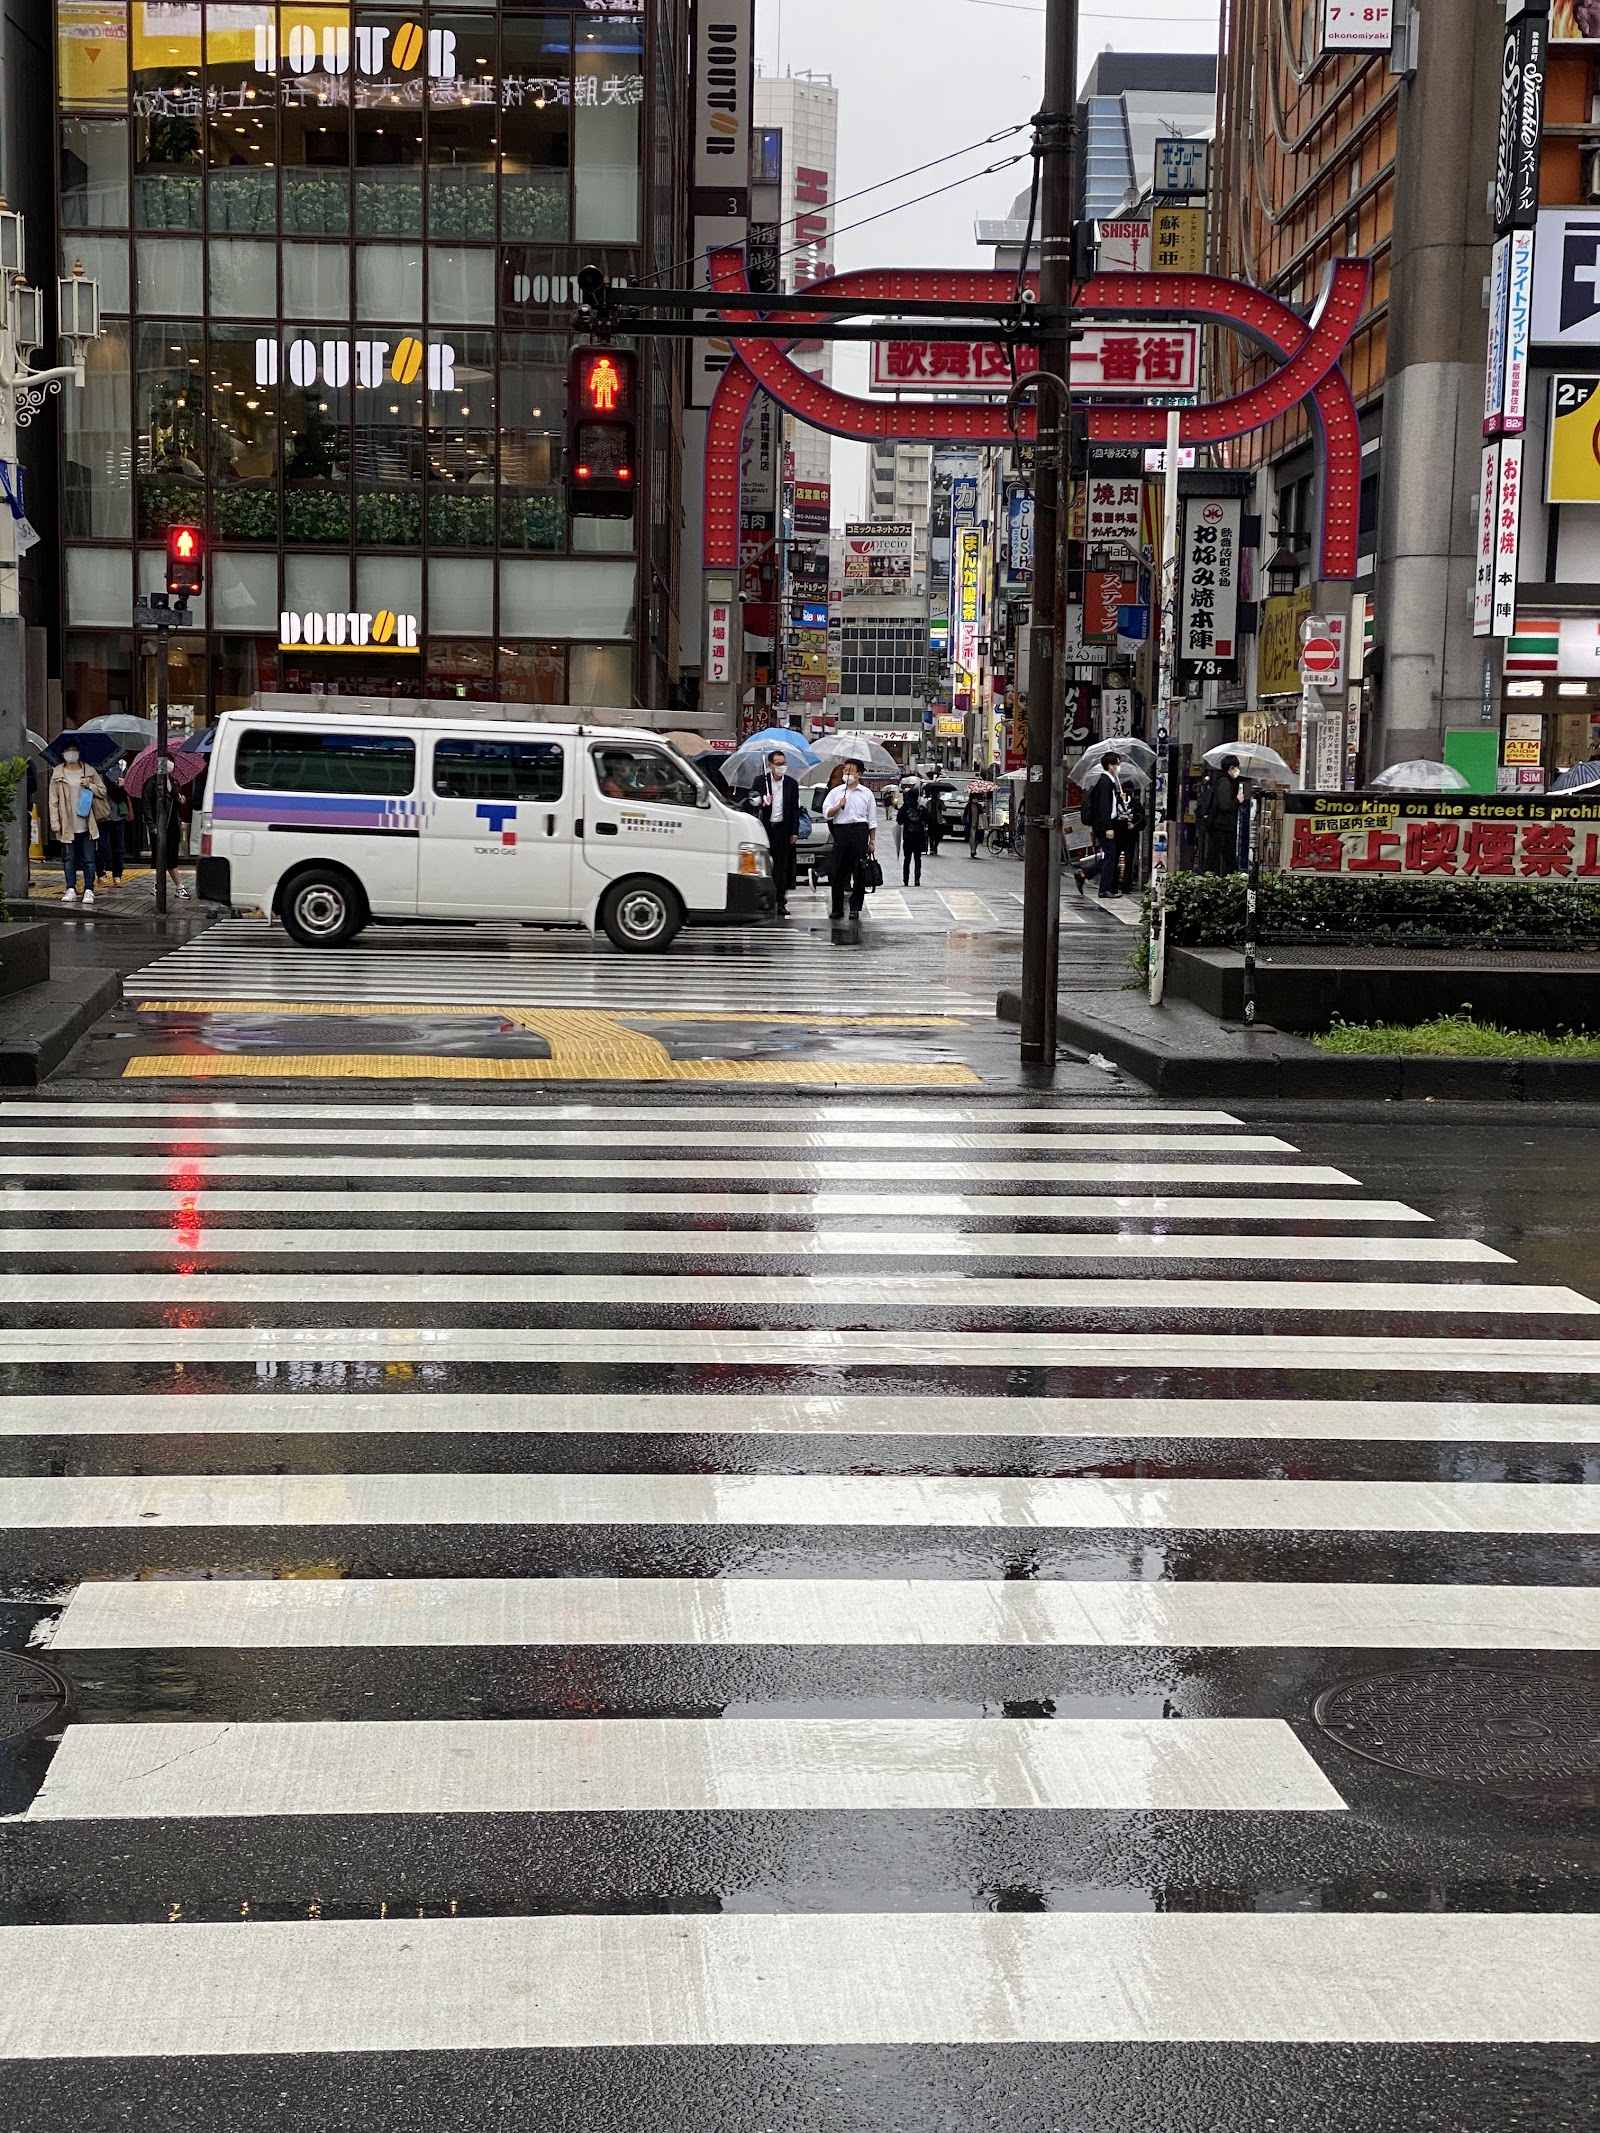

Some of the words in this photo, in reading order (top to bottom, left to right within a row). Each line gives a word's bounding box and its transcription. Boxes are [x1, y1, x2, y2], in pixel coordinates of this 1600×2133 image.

[255, 22, 456, 77] DOUTOR
[1328, 32, 1389, 40] okonomiyaki
[706, 24, 738, 155] DOUTOR
[1520, 62, 1543, 148] Sparkle
[1167, 166, 1196, 189] ビル
[1517, 150, 1535, 210] スパークル
[727, 197, 738, 215] 3
[1101, 223, 1150, 239] SHISHA
[1511, 251, 1530, 361] ファイトフィット
[255, 337, 455, 391] DOUTOR
[1558, 383, 1589, 407] 2F
[1506, 419, 1522, 428] B2F
[796, 488, 829, 501] 店営業中
[1482, 454, 1494, 556] お好み焼
[1500, 458, 1518, 554] お好み焼
[962, 533, 977, 621] まんが喫茶
[1015, 572, 1031, 581] 4F
[1189, 525, 1218, 650] お好み焼本陣
[1496, 572, 1513, 618] 本陣
[280, 610, 417, 647] DOUTOR
[711, 608, 726, 675] 劇場通り
[1303, 674, 1333, 683] 自転車を除く
[1325, 718, 1335, 780] 防犯カメラ作動中
[1507, 741, 1539, 749] ATM
[1523, 773, 1541, 783] SIM
[1314, 815, 1388, 831] 新宿区内全域
[1406, 803, 1427, 815] on
[1434, 800, 1463, 816] the
[1468, 804, 1524, 818] street
[1529, 804, 1545, 817] is
[1550, 804, 1600, 821] prohi
[475, 846, 499, 855] TOKYO
[501, 847, 517, 856] GAS
